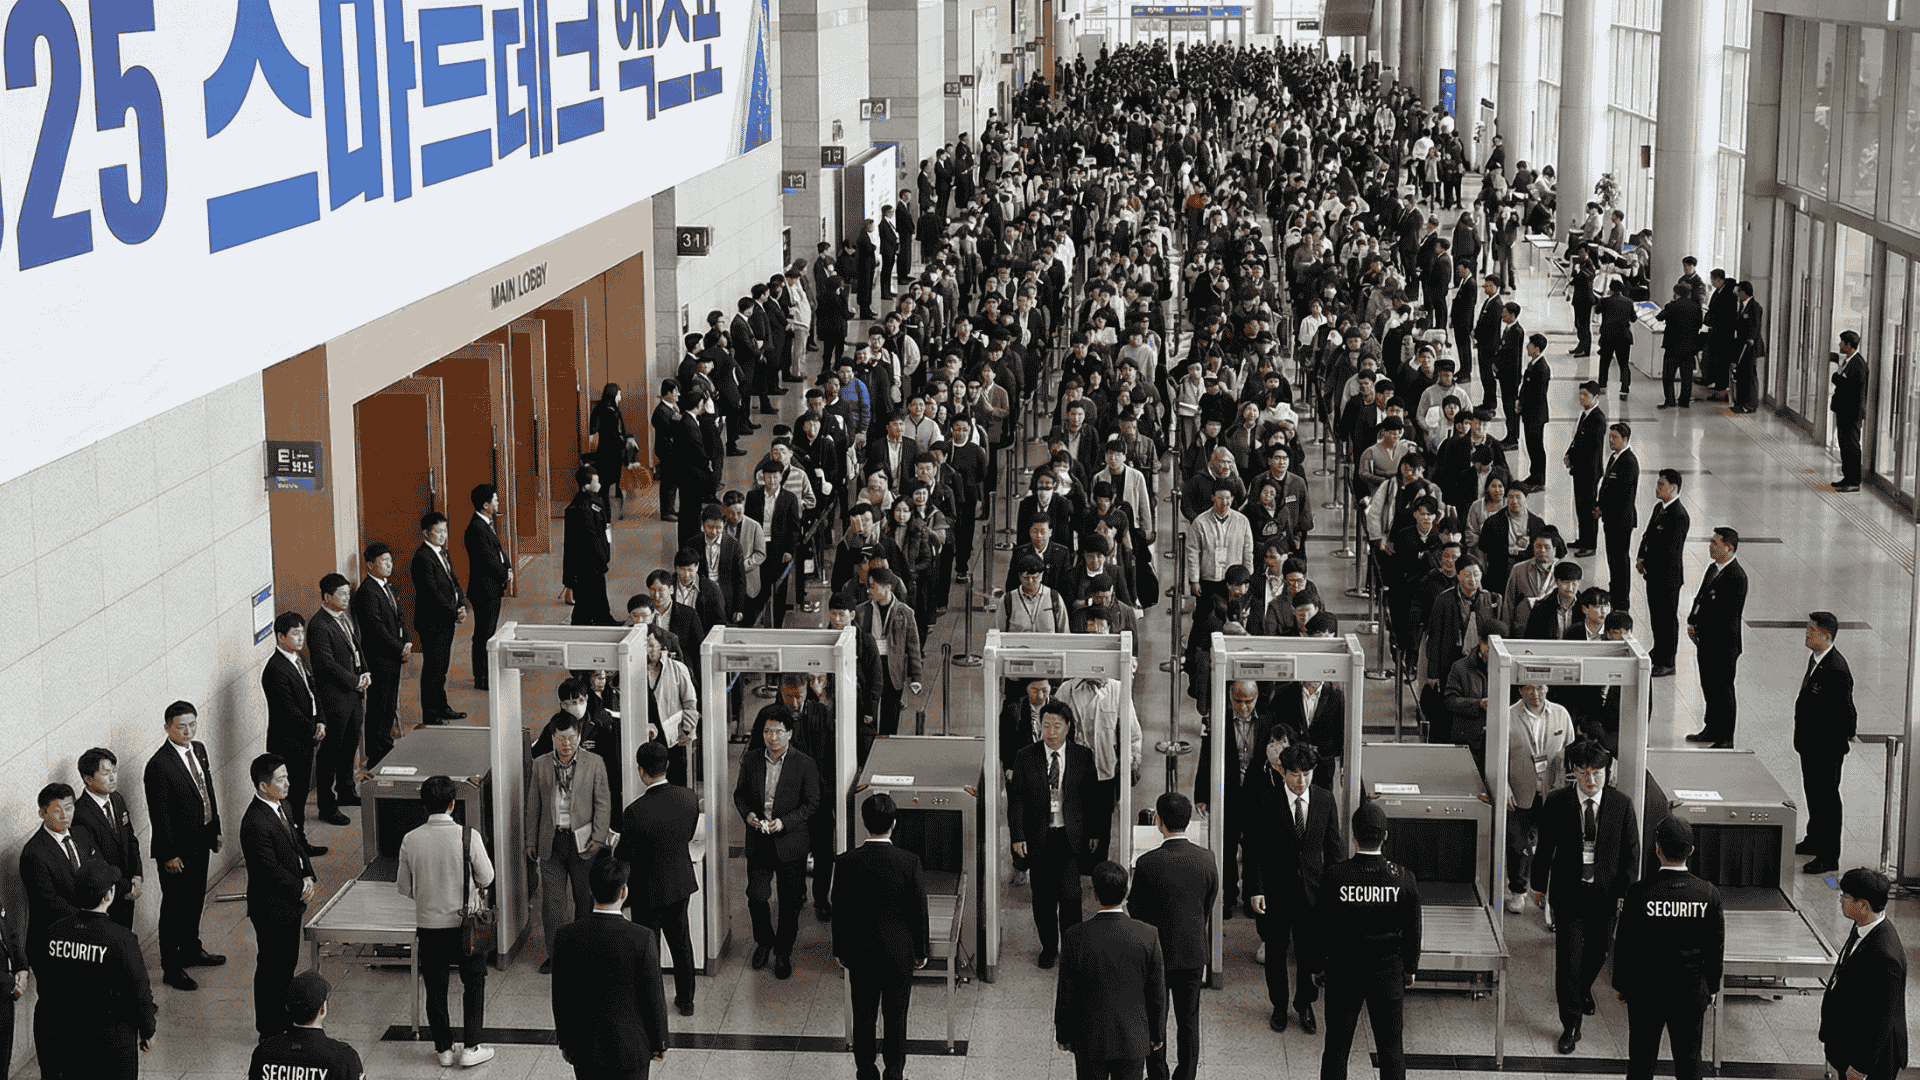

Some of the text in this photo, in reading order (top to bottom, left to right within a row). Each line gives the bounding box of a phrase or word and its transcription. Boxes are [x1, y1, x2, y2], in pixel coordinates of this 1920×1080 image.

[0, 0, 168, 271] 25
[491, 261, 548, 311] MAIN LOBBY
[1339, 885, 1400, 902] SECURITY
[1646, 900, 1708, 918] SECURITY
[49, 940, 108, 963] SECURITY
[262, 1063, 329, 1080] SECURITY
